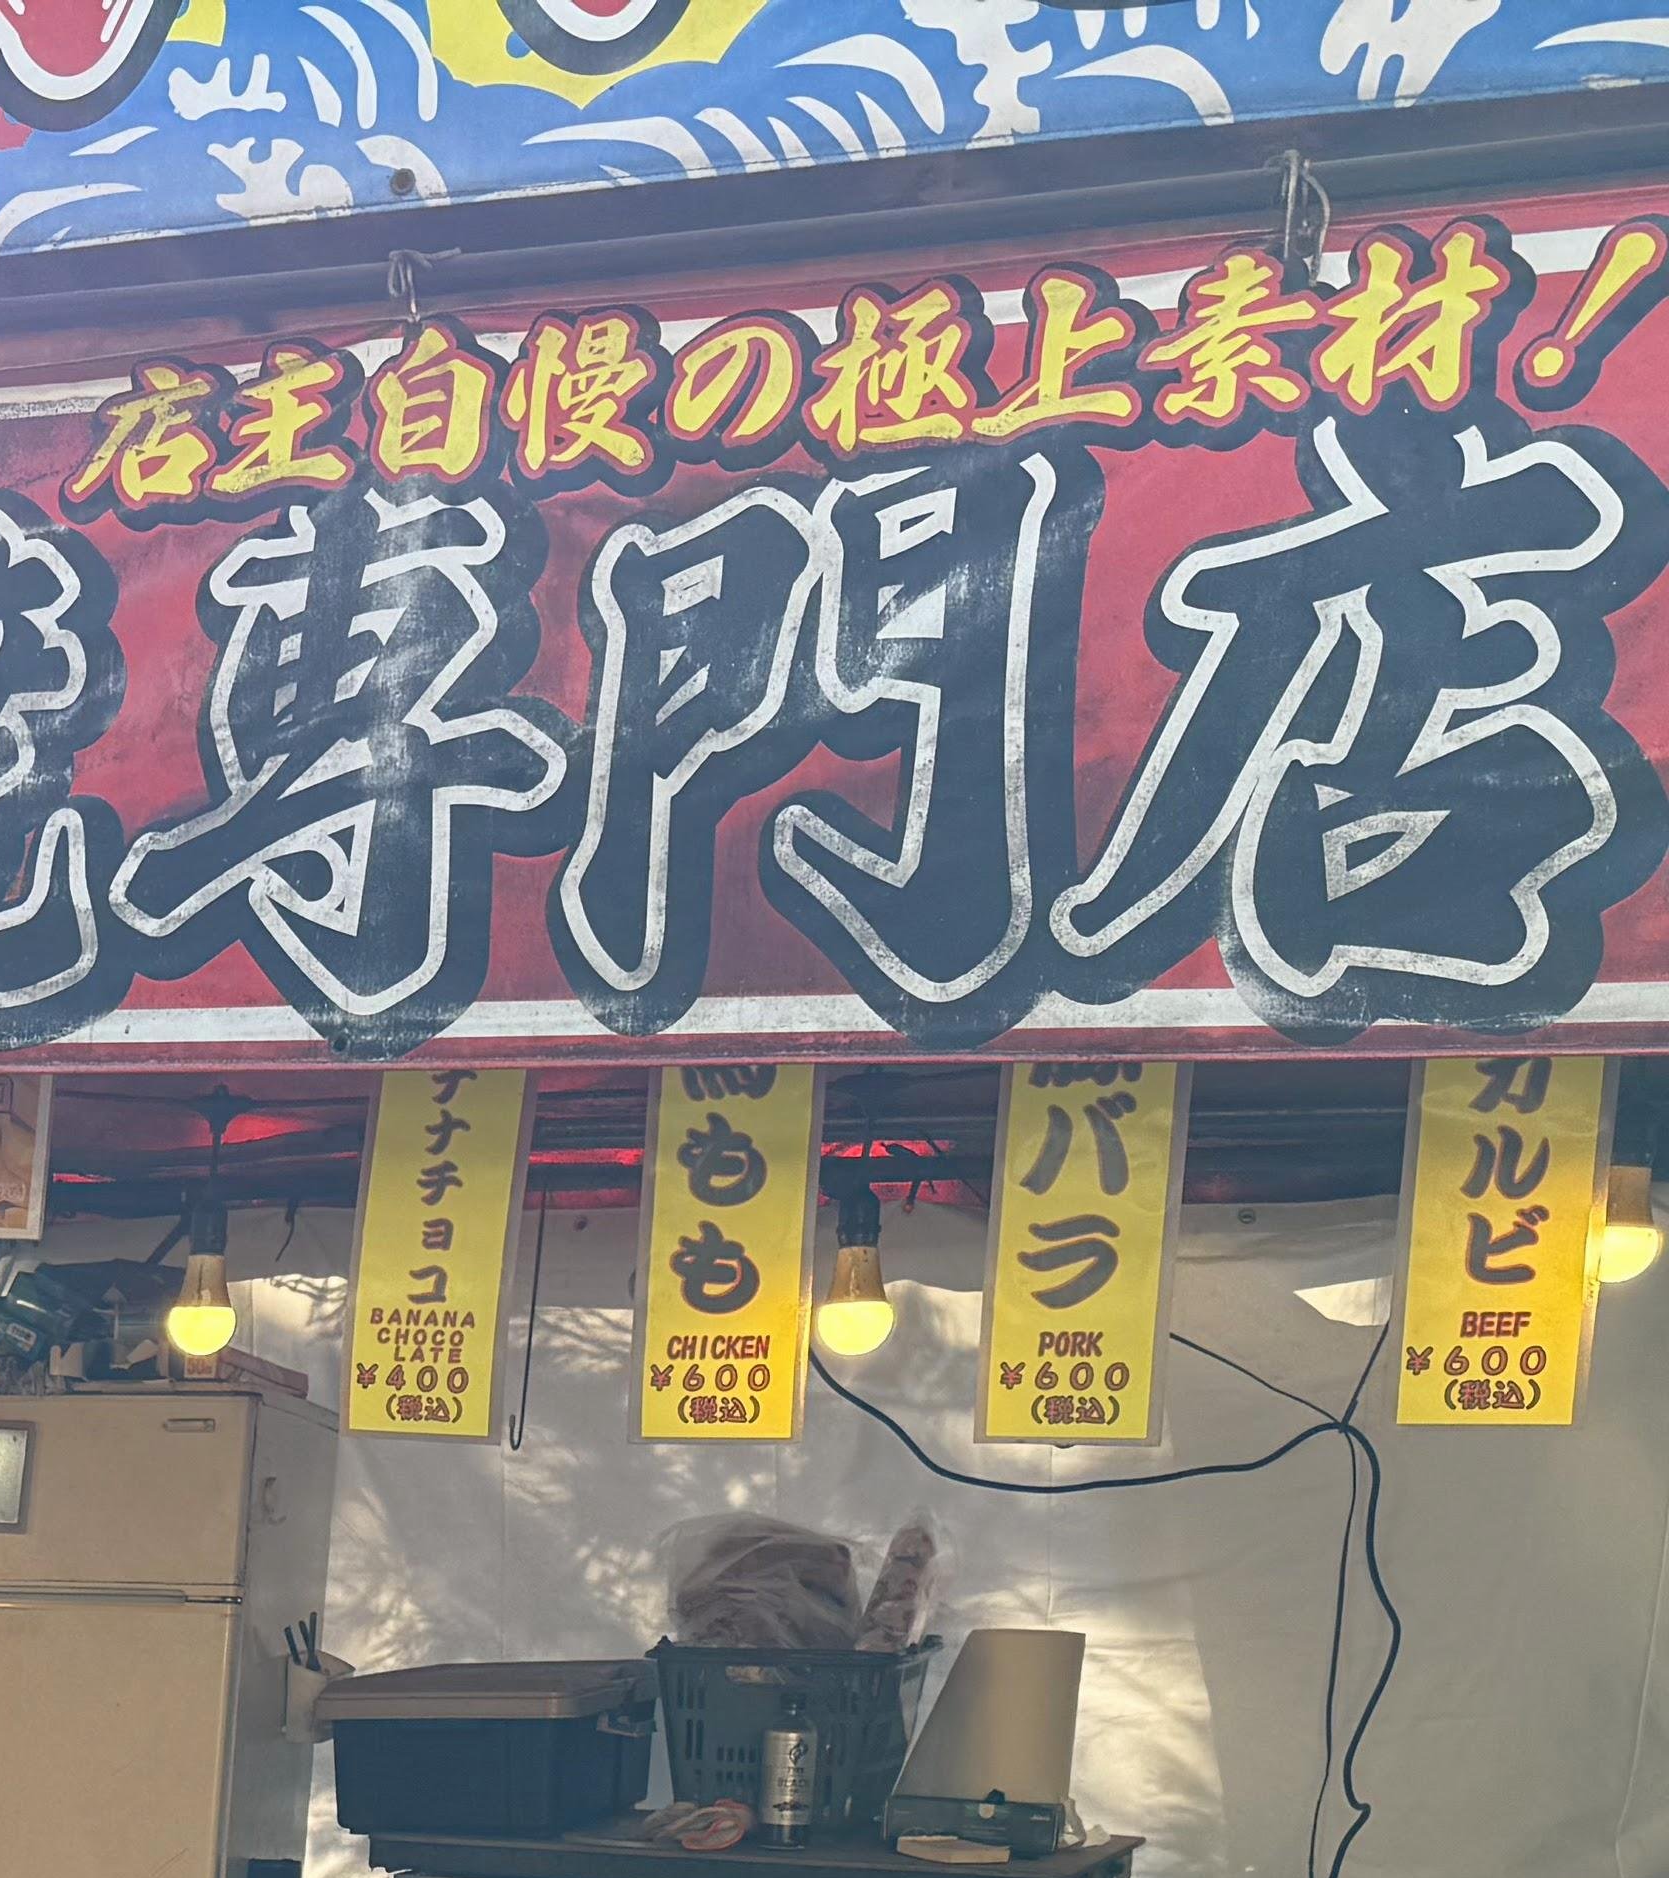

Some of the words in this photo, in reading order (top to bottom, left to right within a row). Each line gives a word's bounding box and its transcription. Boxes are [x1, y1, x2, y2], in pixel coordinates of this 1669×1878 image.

[72, 222, 1665, 508] 店主自慢の極上素材!
[369, 1307, 476, 1329] BANANA
[1459, 1311, 1532, 1339] BEEF
[376, 1327, 465, 1346] CHOCO
[665, 1334, 771, 1362] CHICKEN
[1037, 1331, 1104, 1359] PORK
[393, 1346, 463, 1364] LATE
[1405, 1345, 1548, 1377] ¥600
[356, 1363, 470, 1393] ¥400
[649, 1363, 772, 1392] ¥600
[999, 1362, 1131, 1392] ¥600
[386, 1394, 463, 1424] (税込)
[677, 1395, 761, 1424] (税込)
[1443, 1379, 1542, 1411] (税込)
[1030, 1395, 1121, 1426] (税込)
